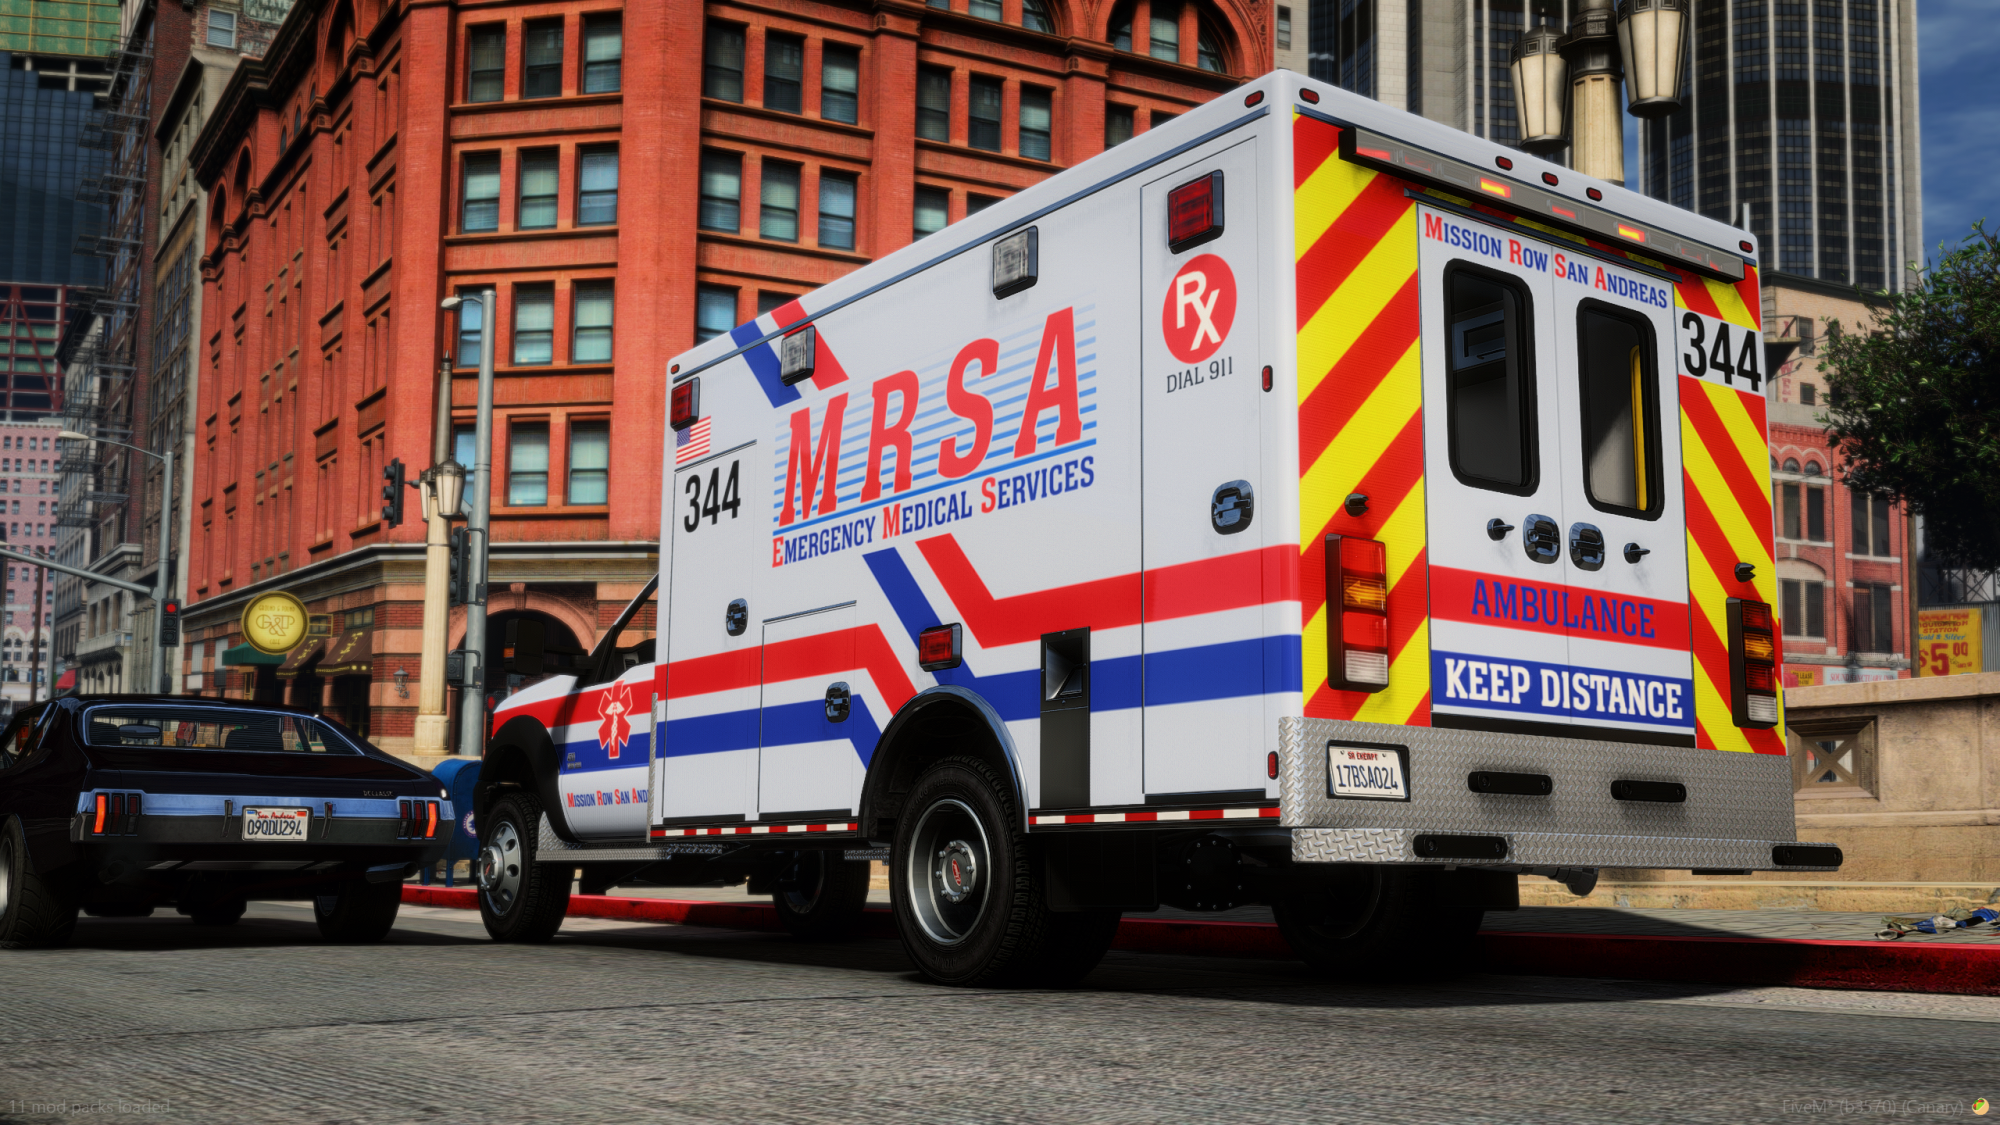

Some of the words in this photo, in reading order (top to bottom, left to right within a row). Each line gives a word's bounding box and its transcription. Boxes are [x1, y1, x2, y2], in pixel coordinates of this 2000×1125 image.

[1166, 367, 1204, 393] DIAL
[1209, 356, 1233, 380] 911
[1682, 311, 1761, 392] 344
[779, 306, 1082, 527] MRSA
[684, 459, 741, 533] 344
[772, 516, 876, 568] EMERGENCY
[882, 490, 973, 540] MEDICAL
[981, 455, 1095, 513] SERVICES
[1471, 578, 1656, 639] AMBULANCE
[1445, 658, 1530, 704] KEEP
[1540, 669, 1683, 719] DISTANCE
[1337, 764, 1399, 790] 17BSA024
[1348, 751, 1355, 760] SA
[257, 811, 269, 819] San
[632, 788, 648, 804] AND
